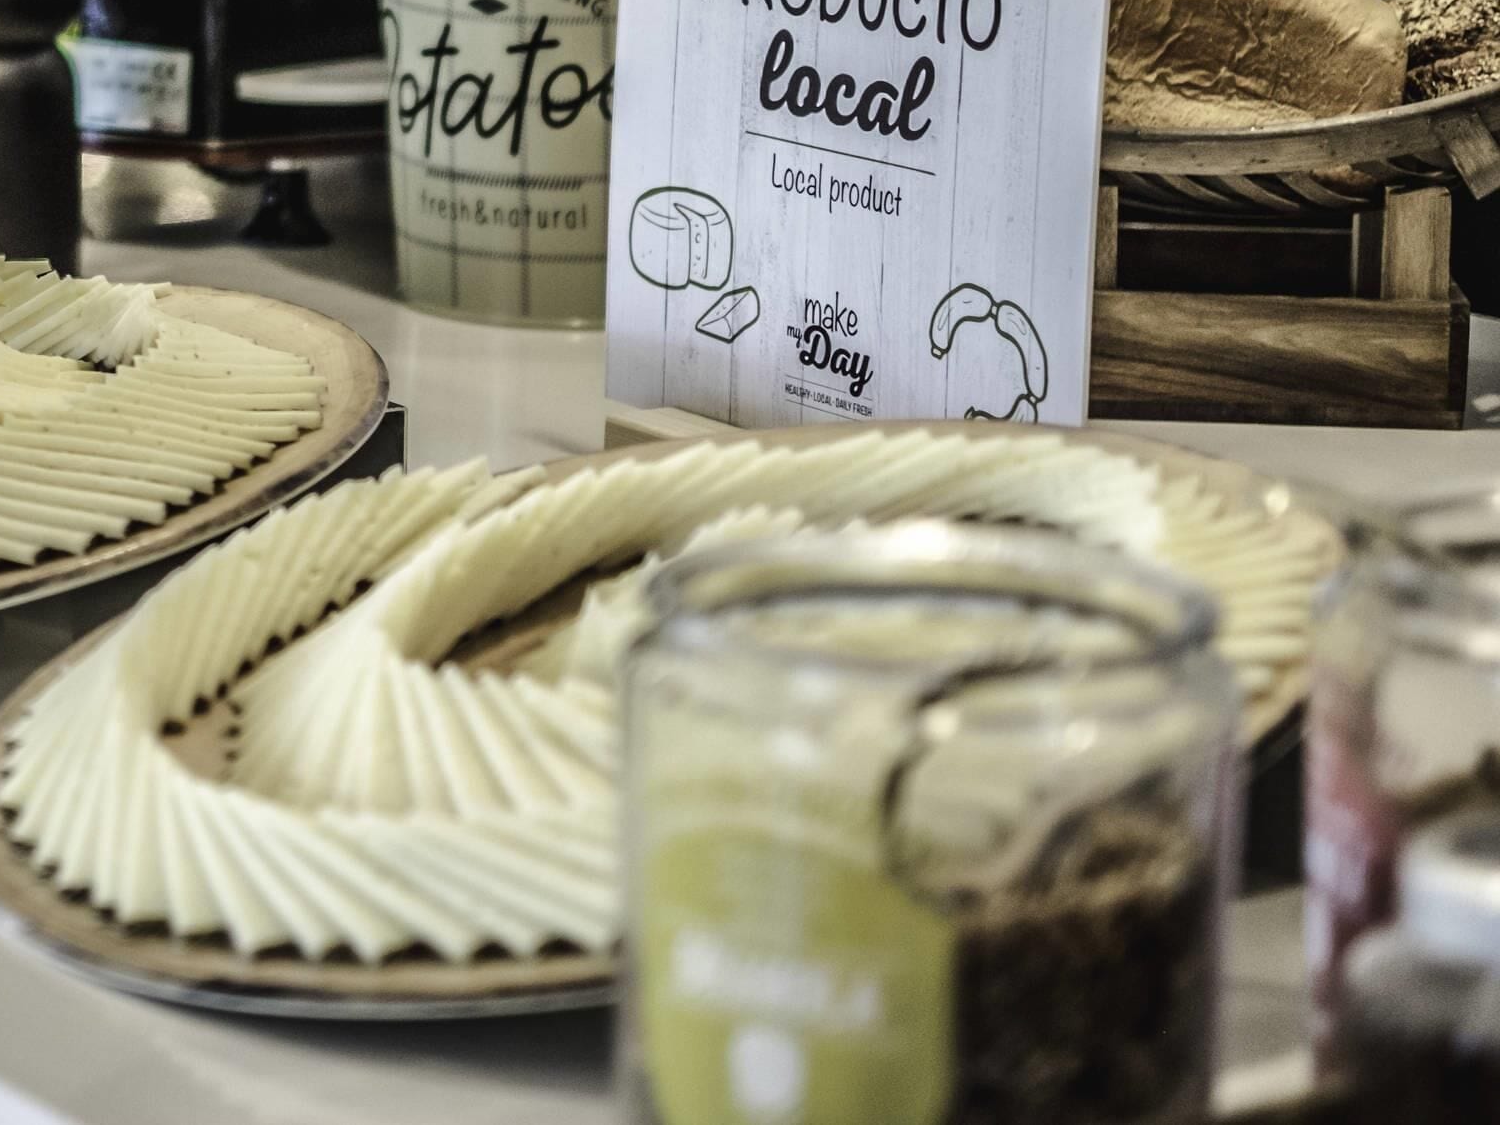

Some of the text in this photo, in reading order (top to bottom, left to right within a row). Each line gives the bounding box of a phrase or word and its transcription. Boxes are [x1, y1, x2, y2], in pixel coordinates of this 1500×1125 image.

[378, 8, 615, 157] otato
[758, 29, 935, 142] local
[771, 153, 902, 216] Local product
[804, 291, 858, 337] make
[786, 325, 874, 397] my Day
[813, 391, 832, 406] LOCAL
[835, 397, 852, 412] DAILY
[853, 402, 873, 418] FRESH
